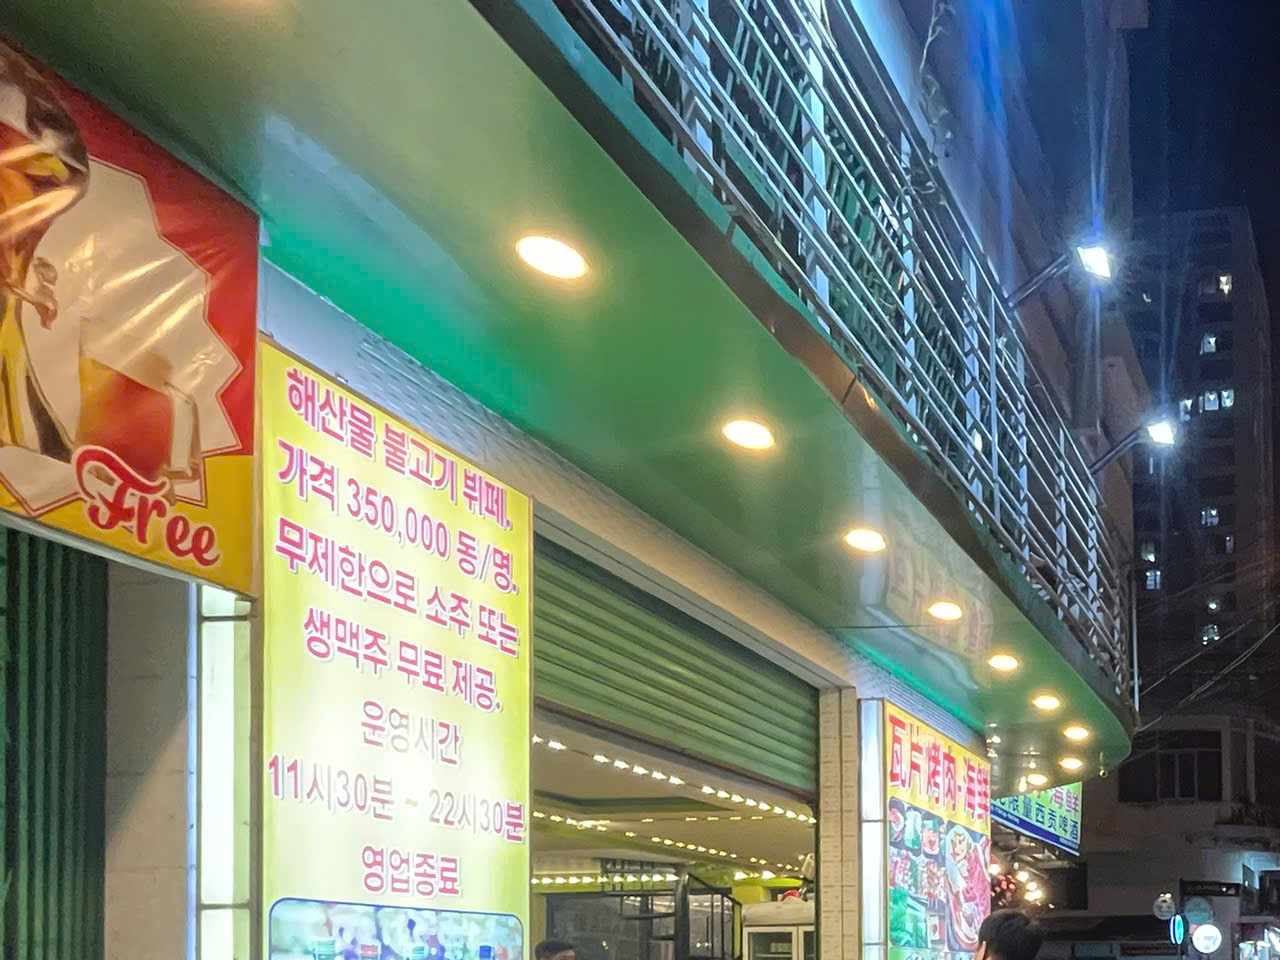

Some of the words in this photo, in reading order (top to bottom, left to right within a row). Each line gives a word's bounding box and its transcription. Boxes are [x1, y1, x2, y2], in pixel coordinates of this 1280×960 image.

[287, 368, 376, 458] 해산물
[383, 423, 457, 501] 불고기
[76, 449, 221, 566] Free
[278, 440, 336, 512] 가격
[347, 478, 449, 558] 350,000
[457, 531, 518, 592] 동/명.
[276, 517, 418, 614] 무제한으로
[426, 586, 471, 635] 소주
[478, 604, 518, 656] 또는
[304, 608, 388, 675] 생맥주
[397, 640, 445, 692] 무료
[451, 659, 501, 711] 제공.
[361, 700, 460, 765] 운영시간
[268, 754, 393, 821] 11시30분
[429, 789, 525, 842] 22시30분
[362, 846, 460, 896] 영업종료
